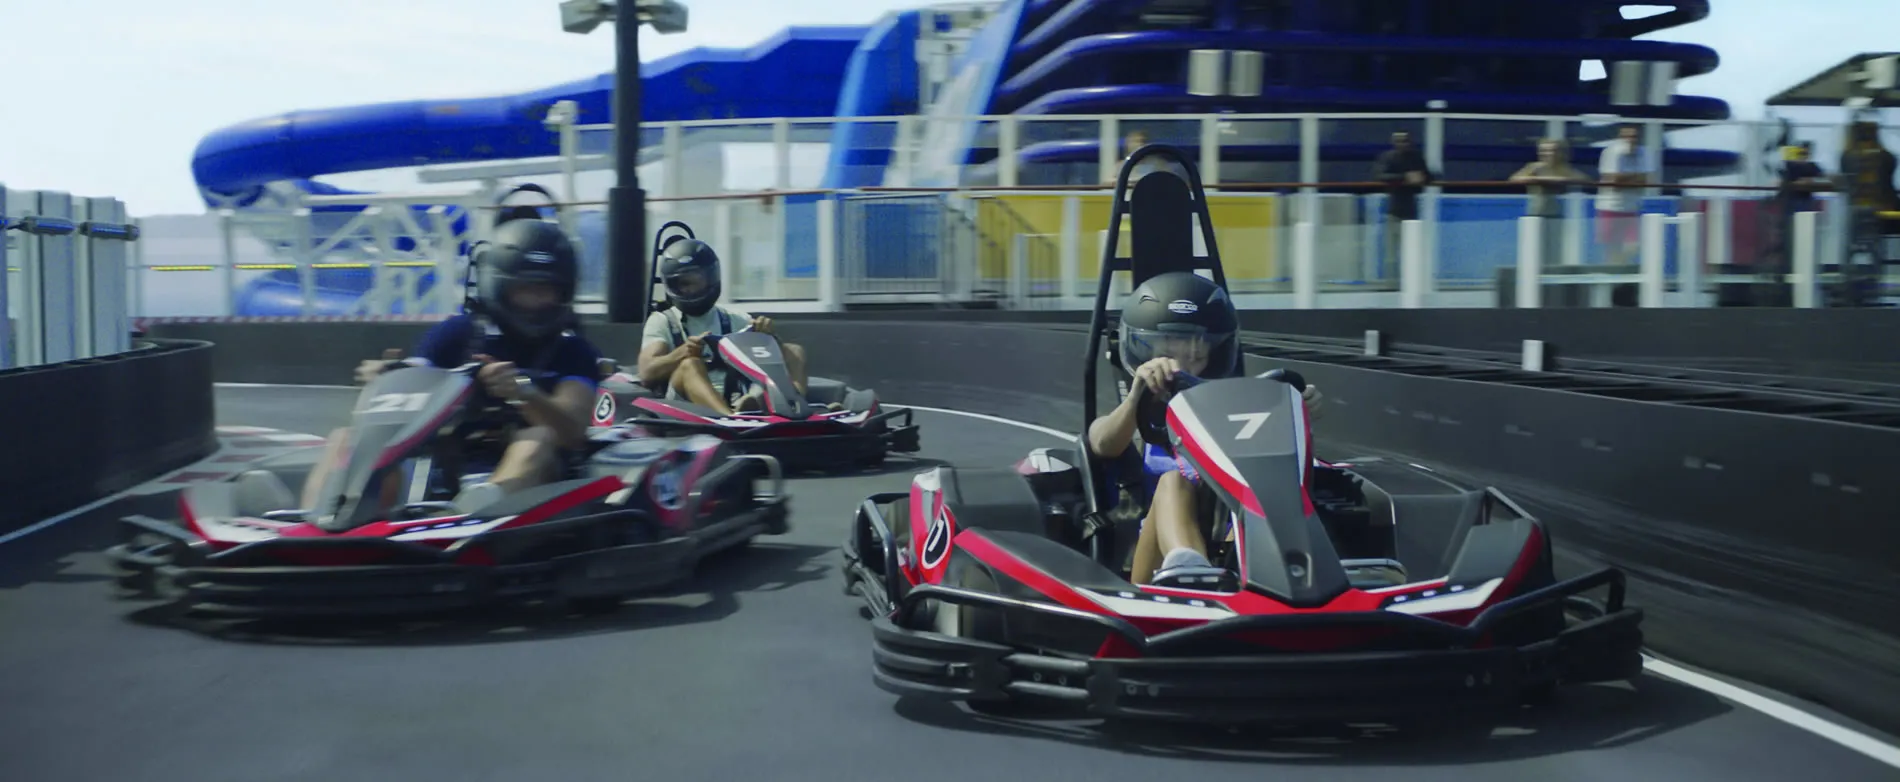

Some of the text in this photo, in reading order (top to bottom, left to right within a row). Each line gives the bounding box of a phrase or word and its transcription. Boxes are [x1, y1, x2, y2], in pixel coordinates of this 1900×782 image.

[751, 346, 771, 358] 5
[365, 392, 432, 414] 21
[1227, 412, 1272, 440] 7
